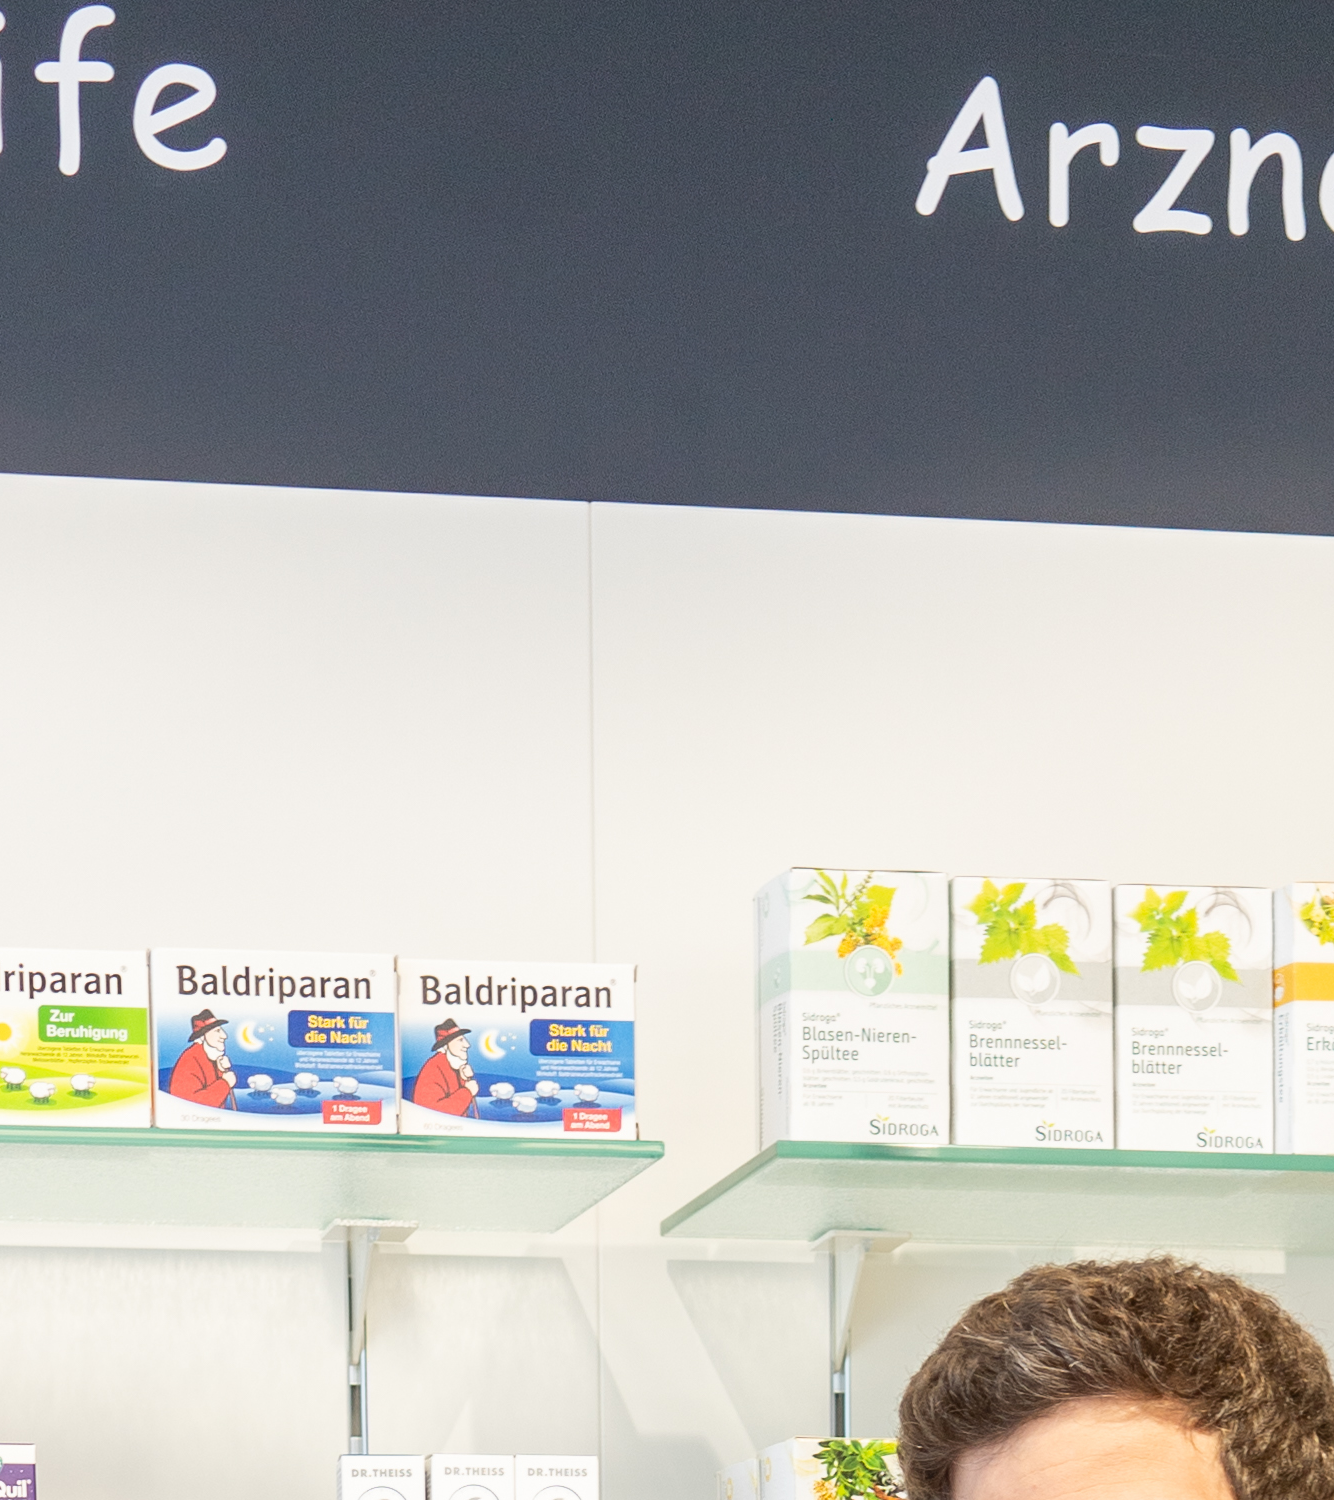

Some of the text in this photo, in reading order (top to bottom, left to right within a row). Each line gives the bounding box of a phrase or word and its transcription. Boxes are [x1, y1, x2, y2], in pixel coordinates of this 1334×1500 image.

[177, 966, 371, 1004] Baldriparan
[420, 976, 612, 1013] Baldriparan
[49, 1009, 74, 1023] Zur
[308, 1015, 368, 1029] Stark für
[47, 1024, 128, 1041] Beruhigung
[305, 1030, 372, 1045] die Nacht
[802, 1026, 916, 1044] Blasen-Nieren-
[969, 1035, 1067, 1050] Brennnessel-
[802, 1045, 859, 1063] Spültee
[969, 1053, 1020, 1068] blätter
[869, 1119, 939, 1137] SIDROGA
[351, 1468, 412, 1478] DR.THEISS
